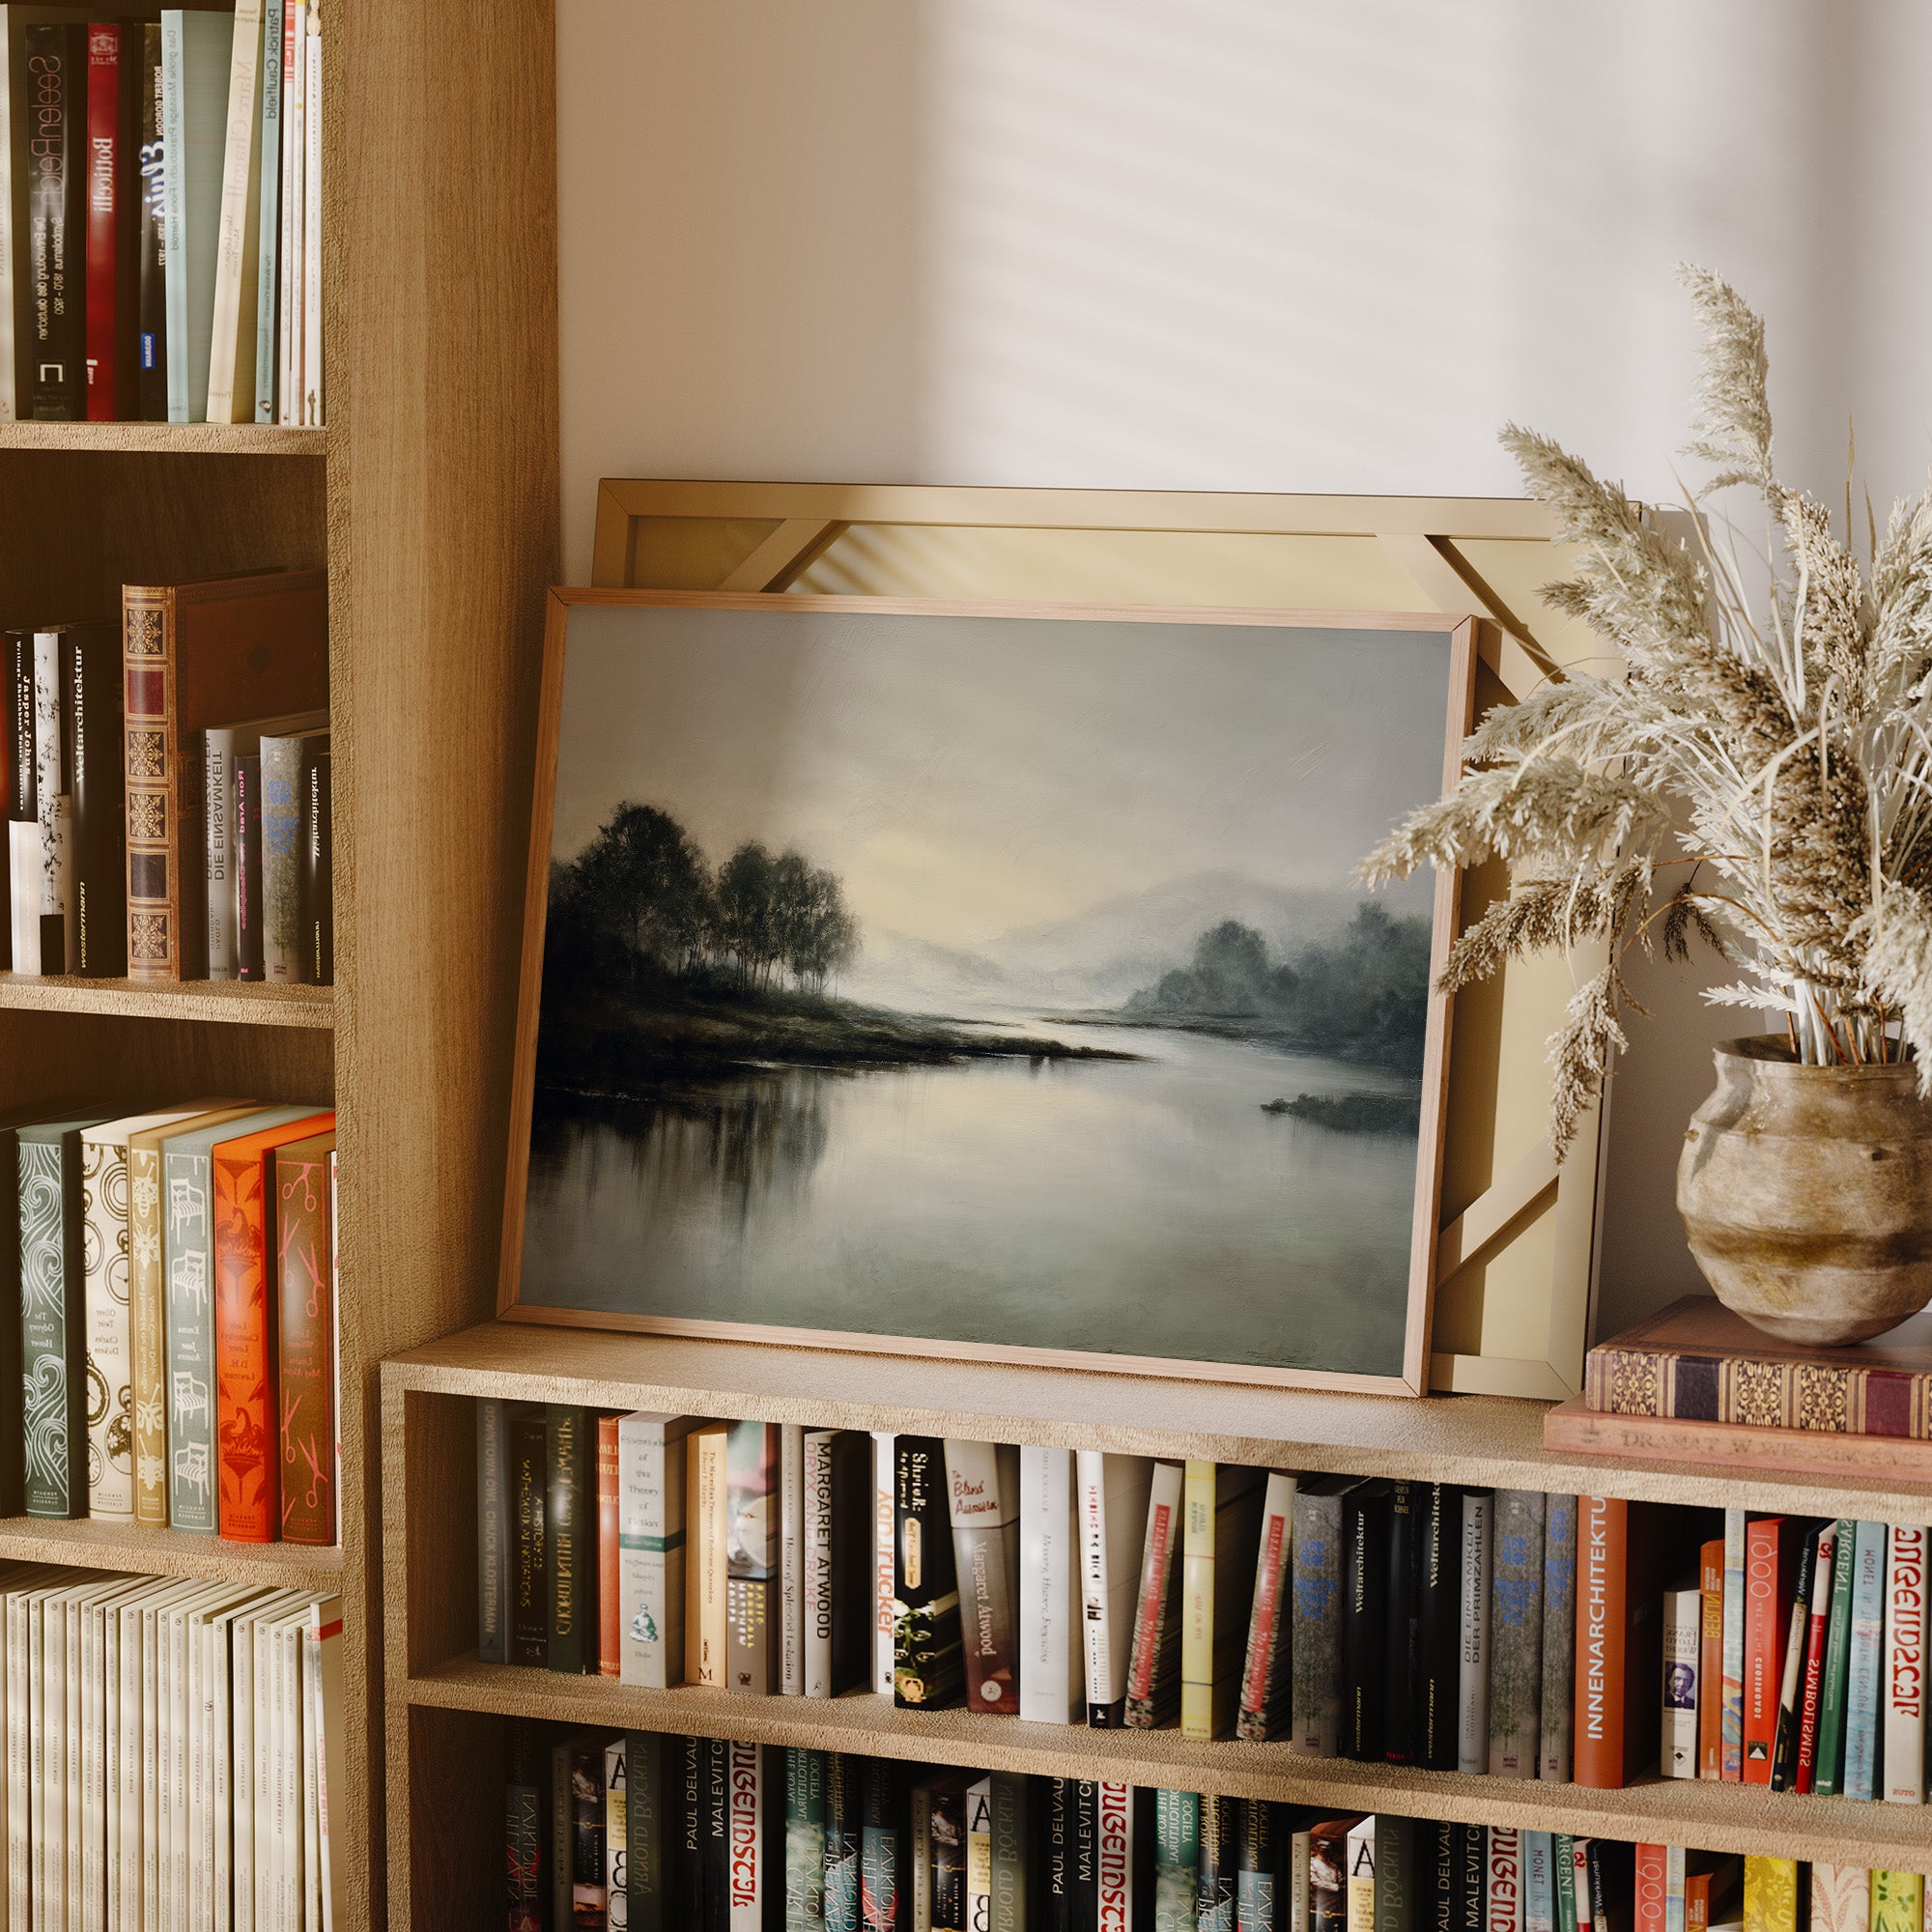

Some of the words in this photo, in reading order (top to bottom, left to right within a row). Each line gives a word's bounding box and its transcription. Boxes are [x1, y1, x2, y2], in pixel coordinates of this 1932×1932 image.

[22, 675, 31, 726] Jasper
[74, 646, 84, 784] Weltarchitektur
[485, 1405, 496, 1477] DOWNTOWN
[638, 1453, 647, 1462] of
[806, 1441, 816, 1492] ORYX
[486, 1479, 496, 1505] OWL
[628, 1485, 659, 1496] Theory
[817, 1442, 830, 1550] MARGARET
[953, 1480, 984, 1497] Blind
[485, 1510, 496, 1551] CHUCK
[627, 1517, 659, 1528] Fiction
[806, 1498, 816, 1542] AND
[785, 1537, 794, 1565] House
[786, 1567, 794, 1582] of
[973, 1541, 988, 1601] Margaret
[1355, 1511, 1365, 1614] Weltarchitektur
[1464, 1522, 1474, 1631] EINSAMKEIT
[1473, 1506, 1483, 1625] PRIMZAHLEN
[485, 1553, 497, 1632] KLOSTERMAN
[806, 1547, 816, 1612] CRAKE
[817, 1556, 831, 1639] ATWOOD
[979, 1605, 997, 1657] Atwood
[1587, 1496, 1607, 1740] INNENARCHITEKTU
[785, 1637, 795, 1681] Isolation
[1464, 1635, 1473, 1663] DIE
[1473, 1628, 1483, 1663] DER
[697, 1668, 713, 1681] M
[687, 1736, 696, 1803] DELVAU
[687, 1808, 696, 1850] PAUL
[733, 1740, 756, 1907] JUGENDSTIL
[1053, 1777, 1064, 1844] DELVAU
[1053, 1851, 1064, 1894] PAUL
[1535, 1848, 1544, 1886] MONET
[1558, 1834, 1574, 1899] ARGENT
[1576, 1852, 1586, 1867] 2
[1594, 1861, 1604, 1908] Werkkunst
[1637, 1857, 1662, 1918] 1900
